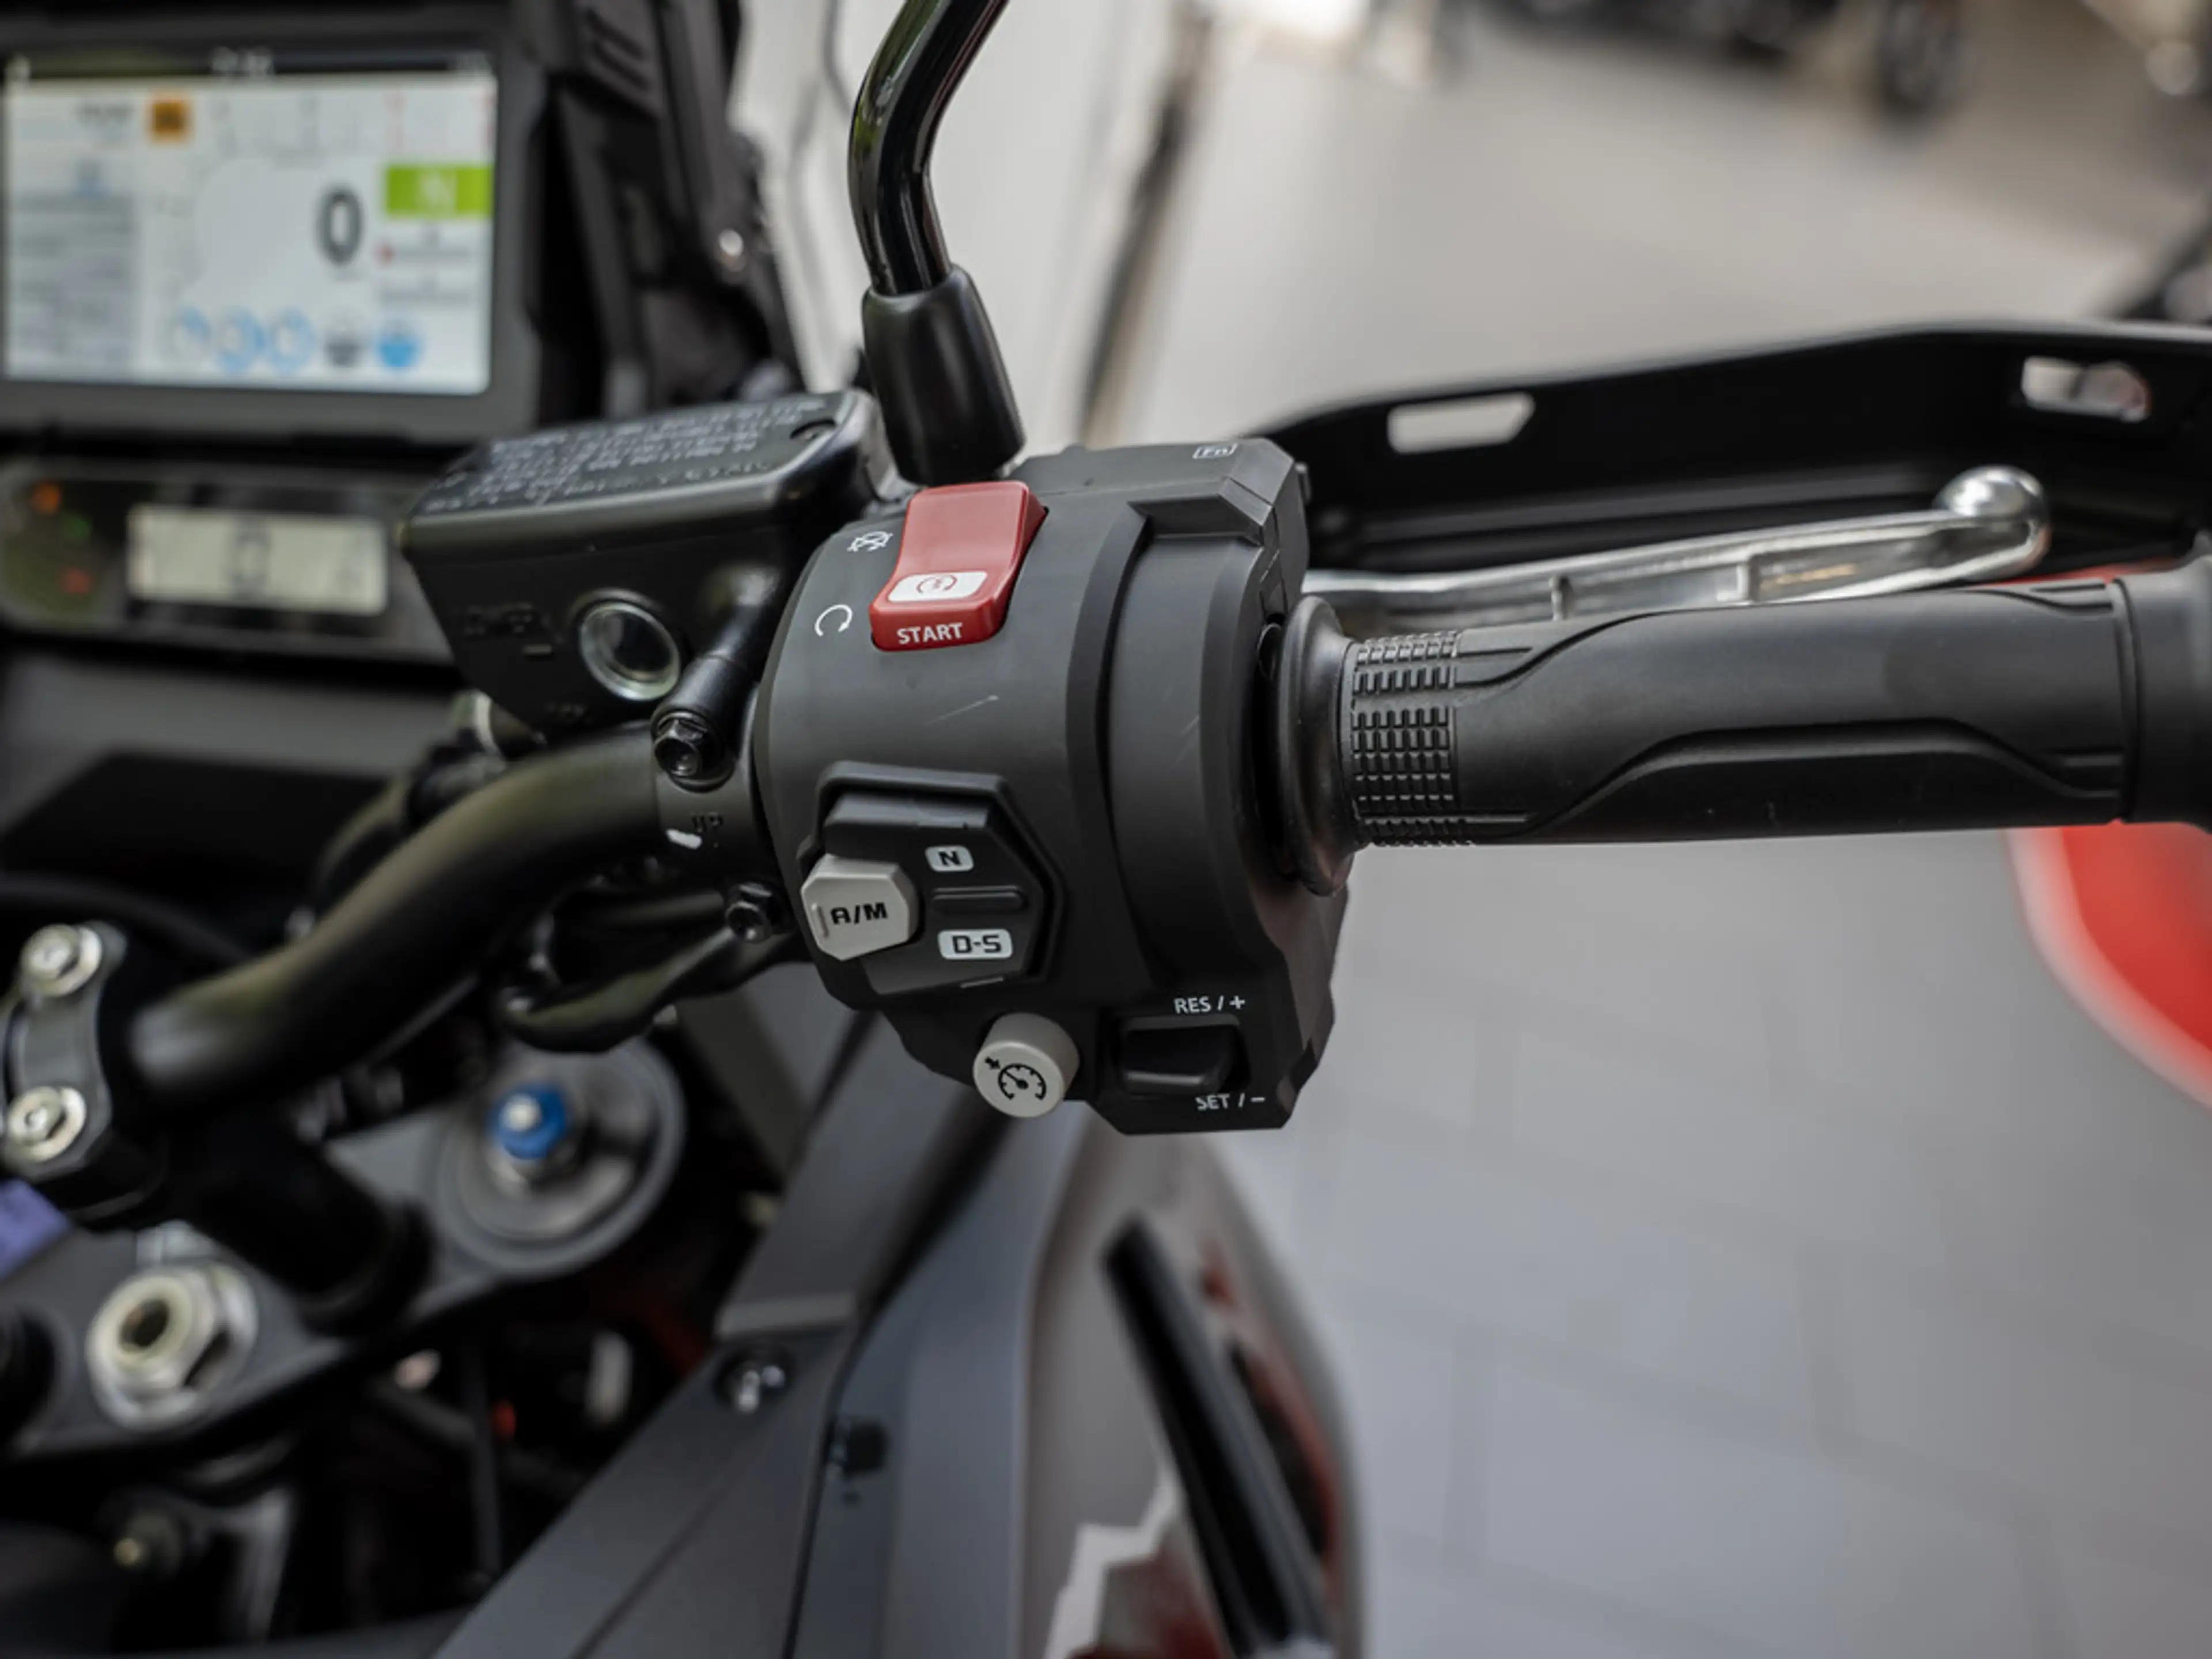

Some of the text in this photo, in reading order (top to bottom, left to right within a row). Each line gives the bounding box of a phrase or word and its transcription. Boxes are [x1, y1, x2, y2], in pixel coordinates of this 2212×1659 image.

[316, 184, 363, 266] 0
[896, 622, 963, 645] START
[938, 850, 961, 867] N
[831, 902, 888, 925] A/M
[952, 934, 1002, 955] D-S
[1174, 995, 1211, 1014] RES
[1195, 1093, 1230, 1111] SET
